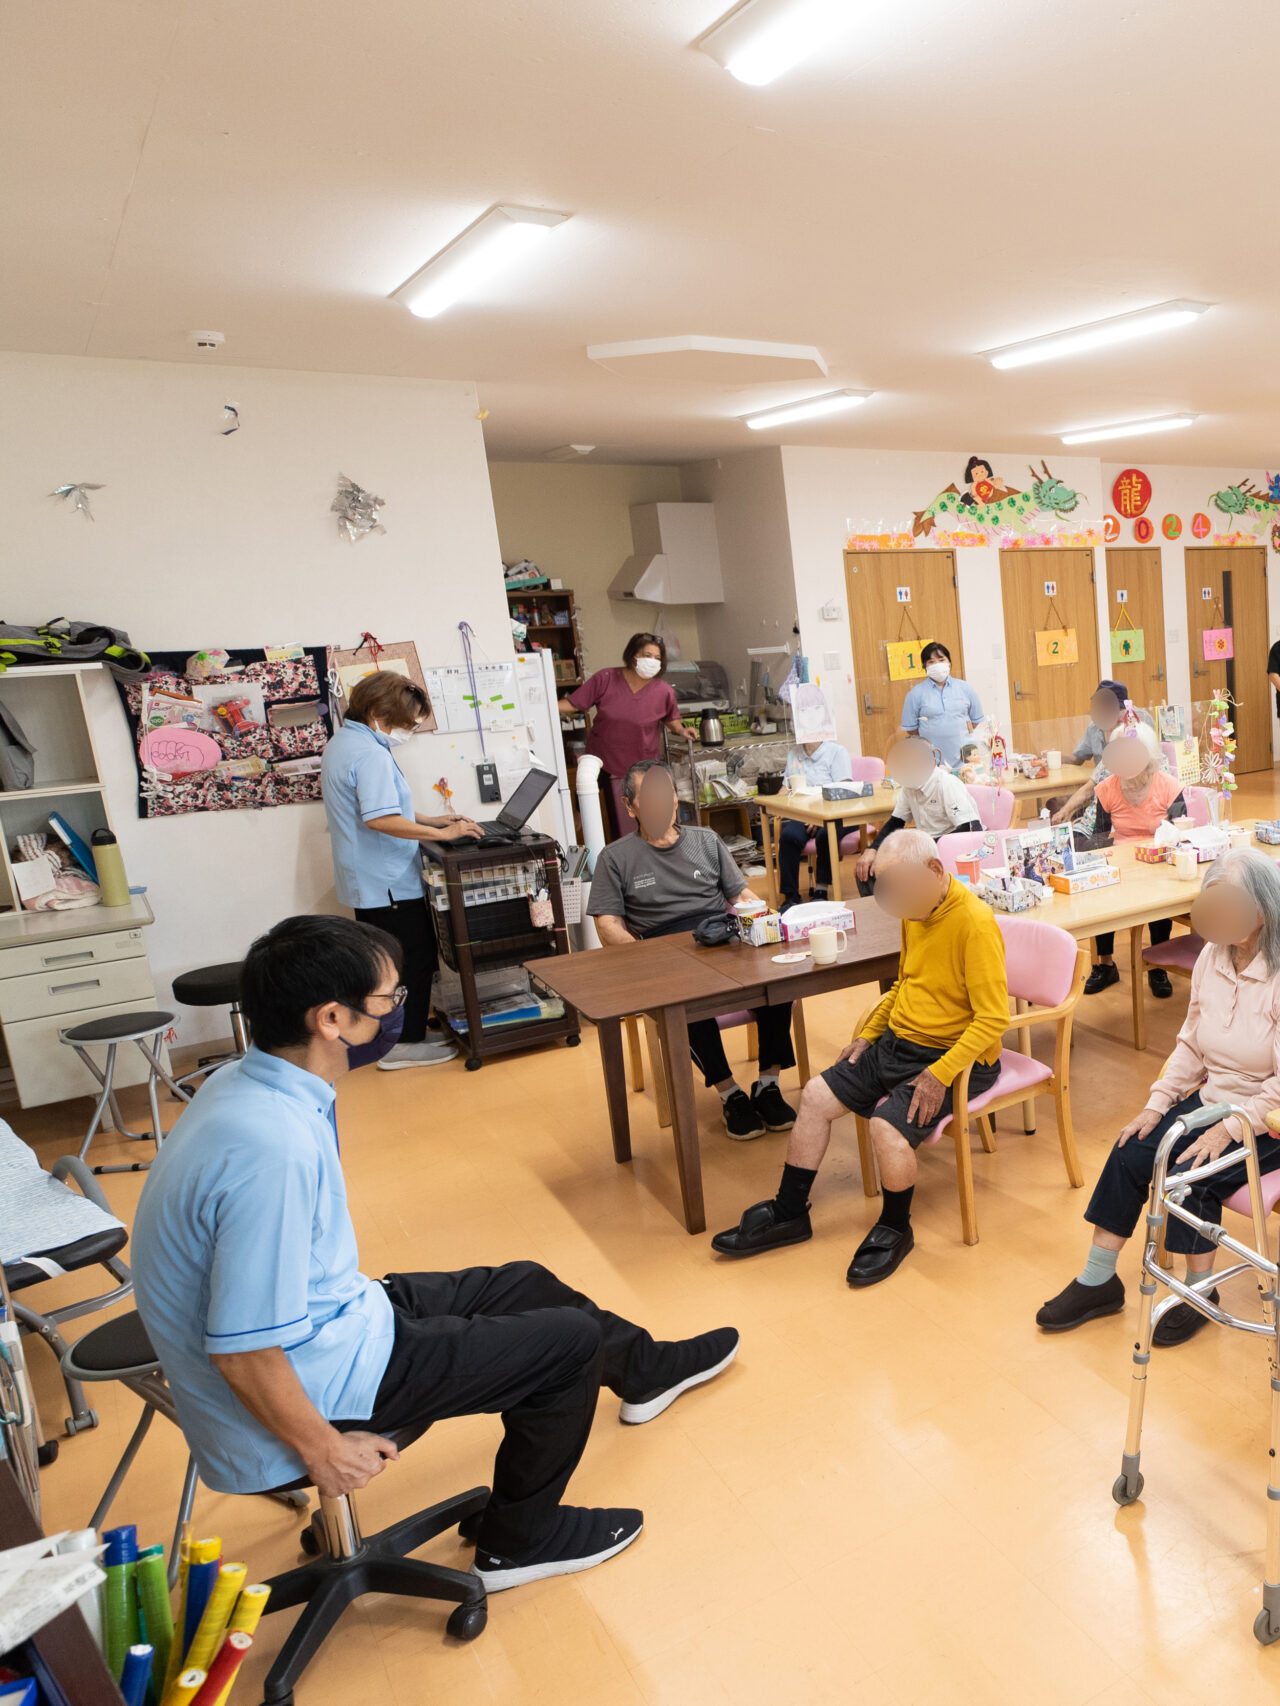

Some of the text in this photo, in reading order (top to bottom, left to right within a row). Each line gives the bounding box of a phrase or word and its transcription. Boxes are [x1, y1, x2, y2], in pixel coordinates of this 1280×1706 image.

[1118, 474, 1151, 515] 龍
[1052, 641, 1059, 654] 2
[906, 653, 915, 669] 1
